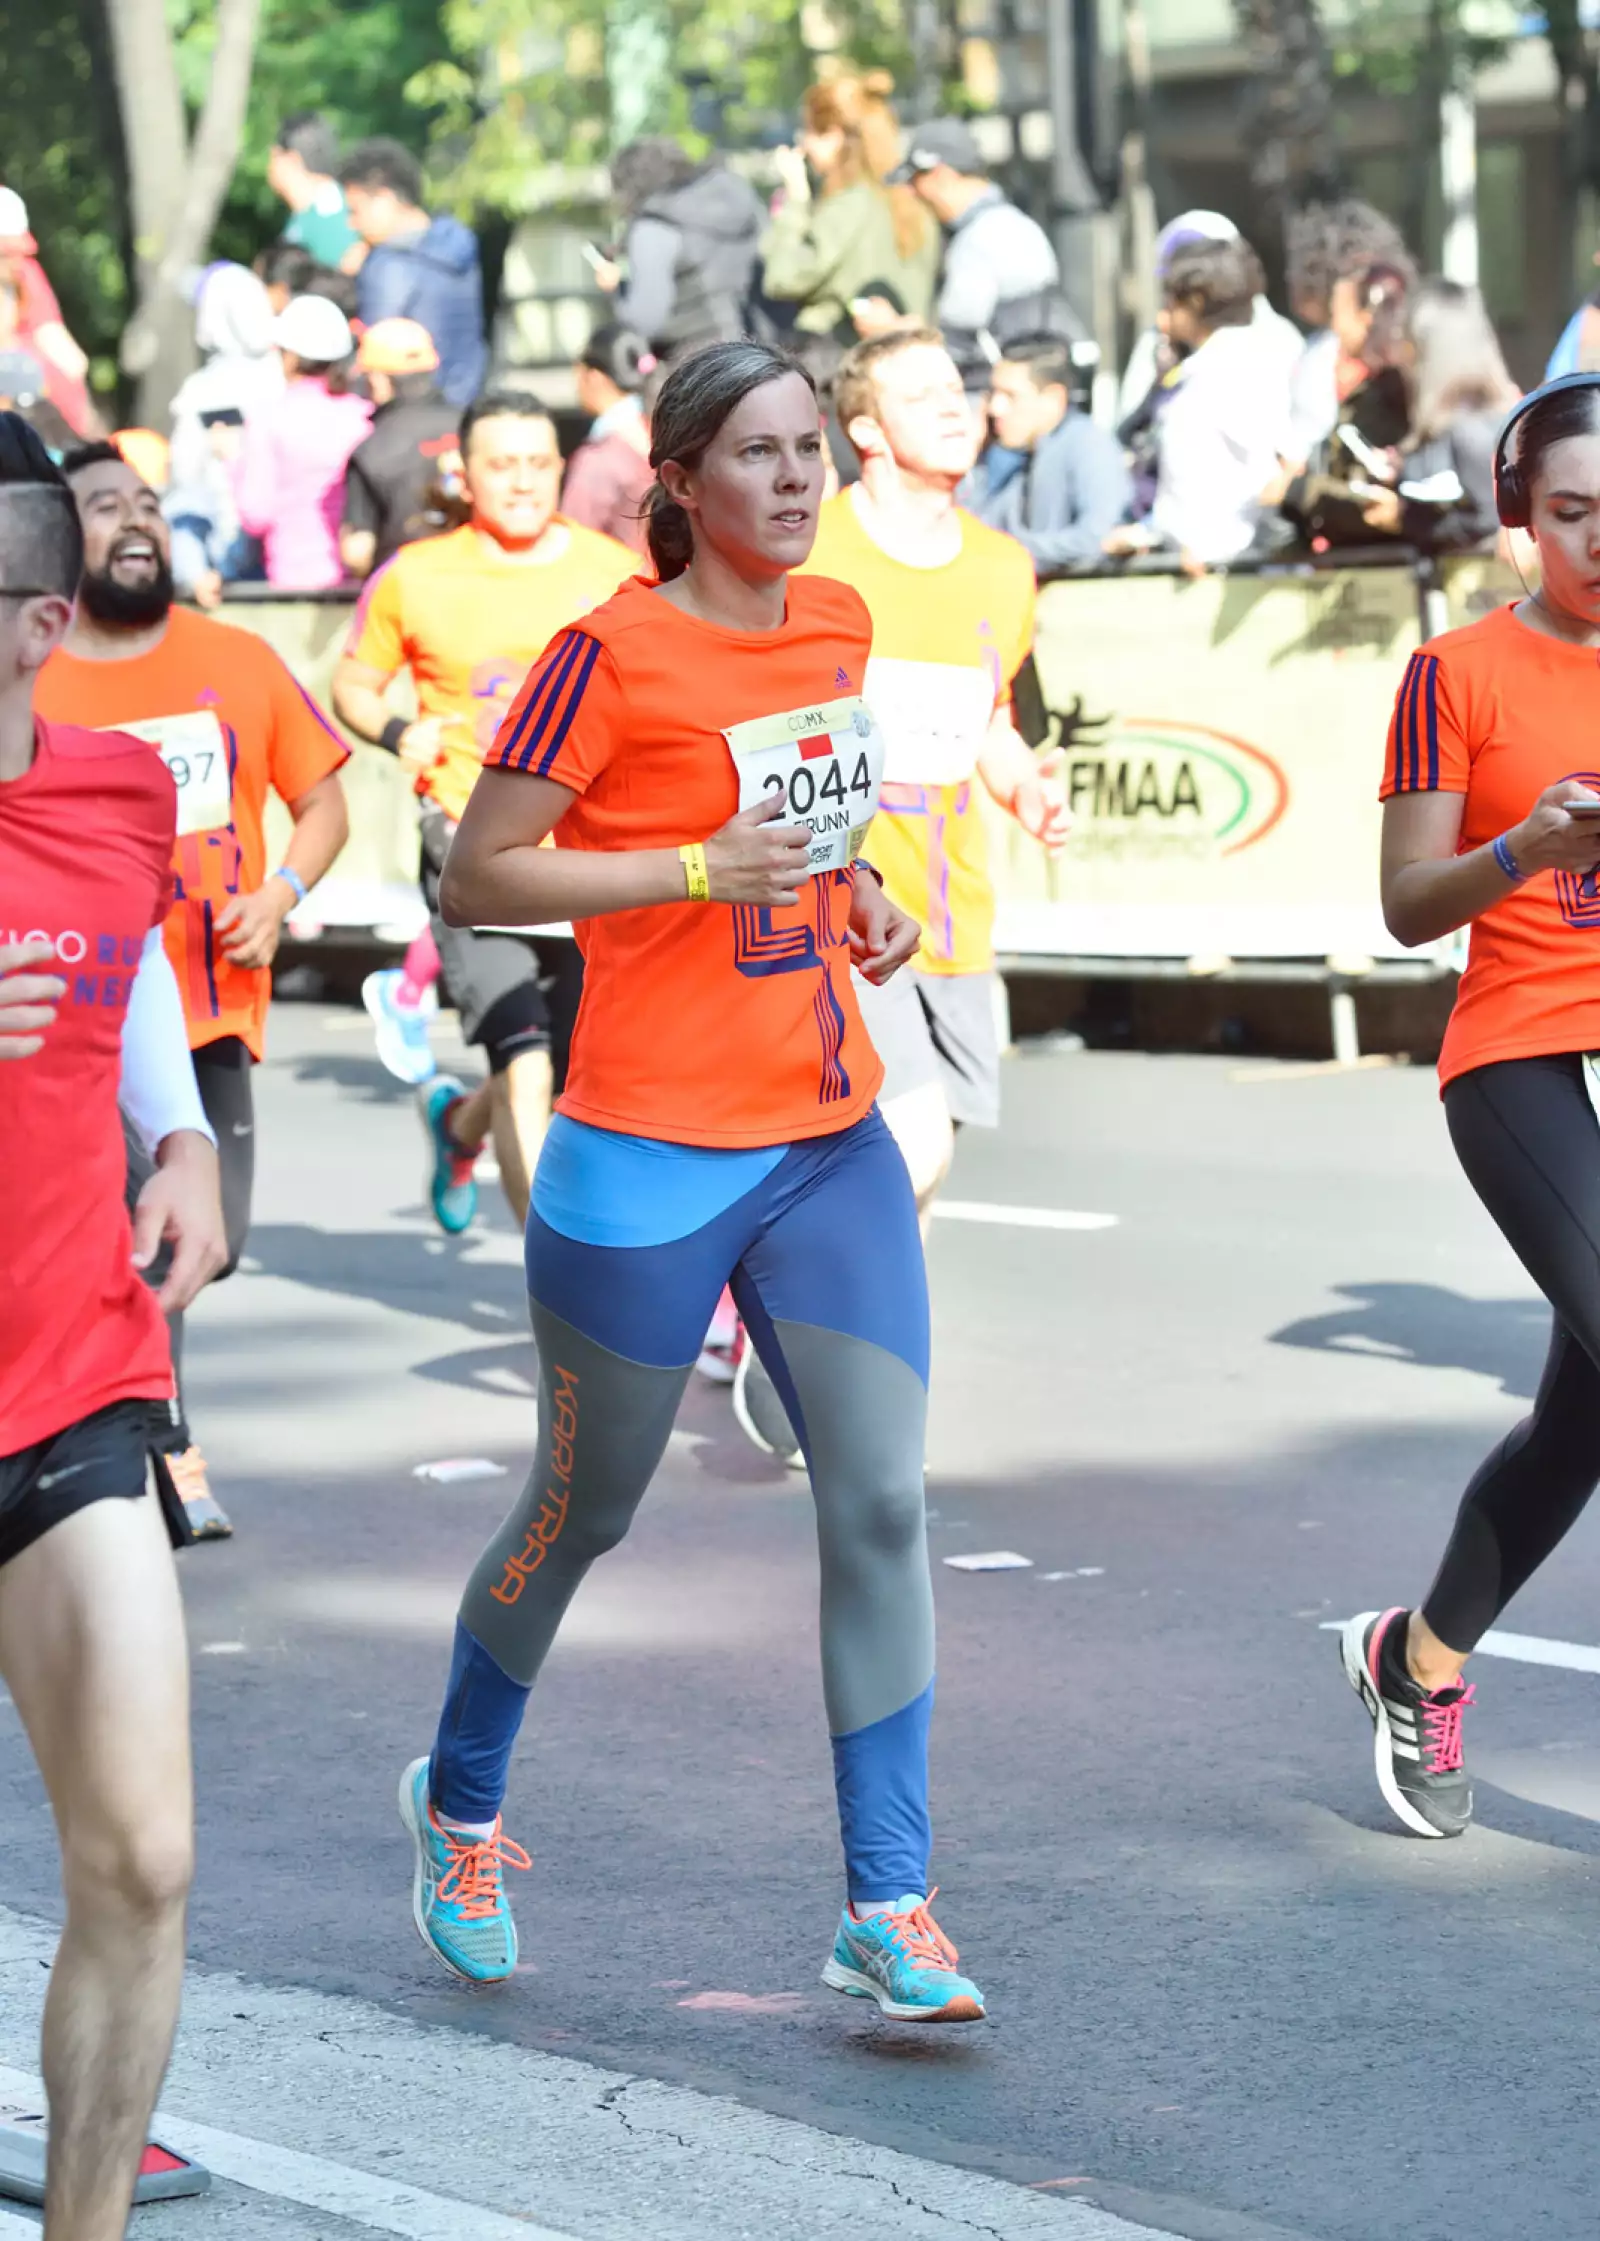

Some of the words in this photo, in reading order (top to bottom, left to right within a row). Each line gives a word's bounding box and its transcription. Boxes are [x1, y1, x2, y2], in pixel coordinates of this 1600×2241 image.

[788, 710, 828, 732] CDMX
[762, 751, 872, 821] 2044
[1069, 761, 1202, 816] FMAA
[794, 809, 850, 835] RUNN
[811, 843, 834, 857] SPORT
[815, 852, 832, 864] CITY
[551, 1364, 580, 1484] KARI
[489, 1488, 571, 1606] TRAA
